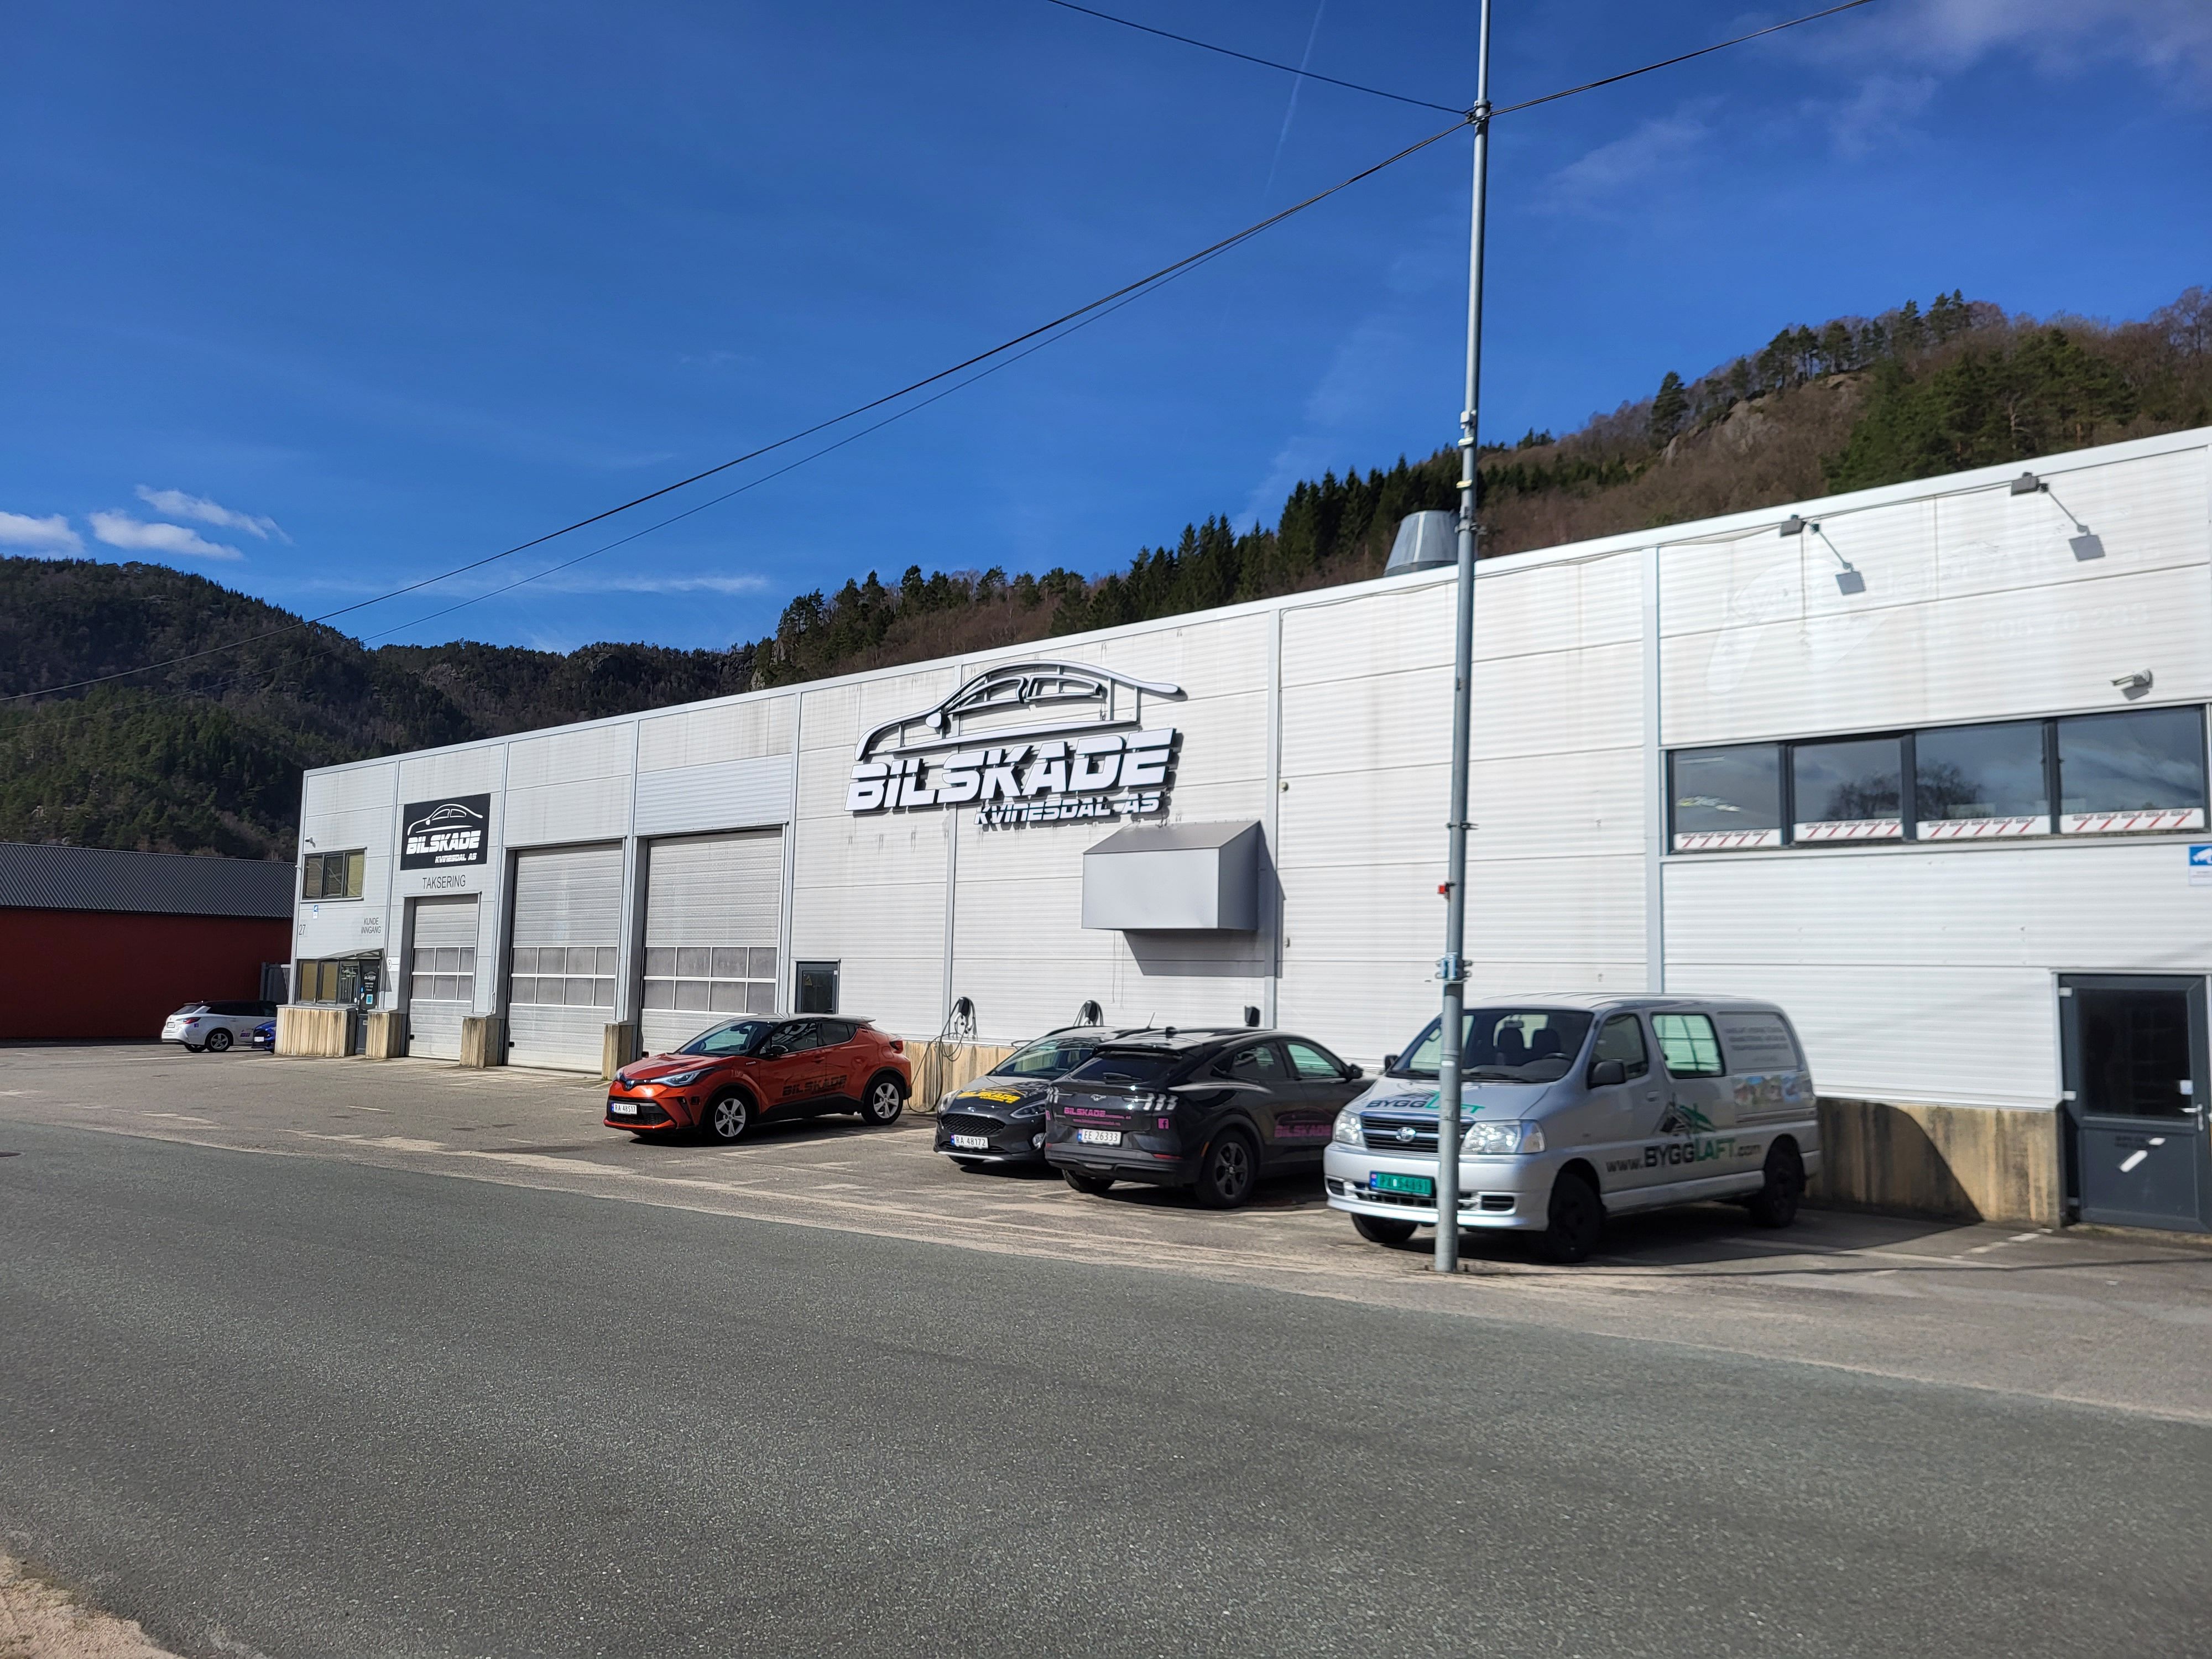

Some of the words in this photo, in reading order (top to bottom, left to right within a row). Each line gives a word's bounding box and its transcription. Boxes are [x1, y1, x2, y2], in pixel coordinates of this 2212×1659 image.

[844, 727, 1176, 811] BILSKADE
[974, 796, 1111, 825] KVINESDAL
[1121, 791, 1161, 814] AS
[406, 830, 481, 855] BILSKADE
[435, 853, 467, 863] KVINESDAL
[468, 852, 477, 861] AS
[422, 874, 466, 890] TAKSERING
[299, 924, 306, 936] 27
[361, 926, 381, 934] INNGANG
[1063, 1107, 1106, 1118] BILSKADE
[956, 1136, 964, 1145] RA
[967, 1138, 985, 1146] 48172
[1084, 1130, 1092, 1140] EE
[1095, 1131, 1118, 1142] 26333
